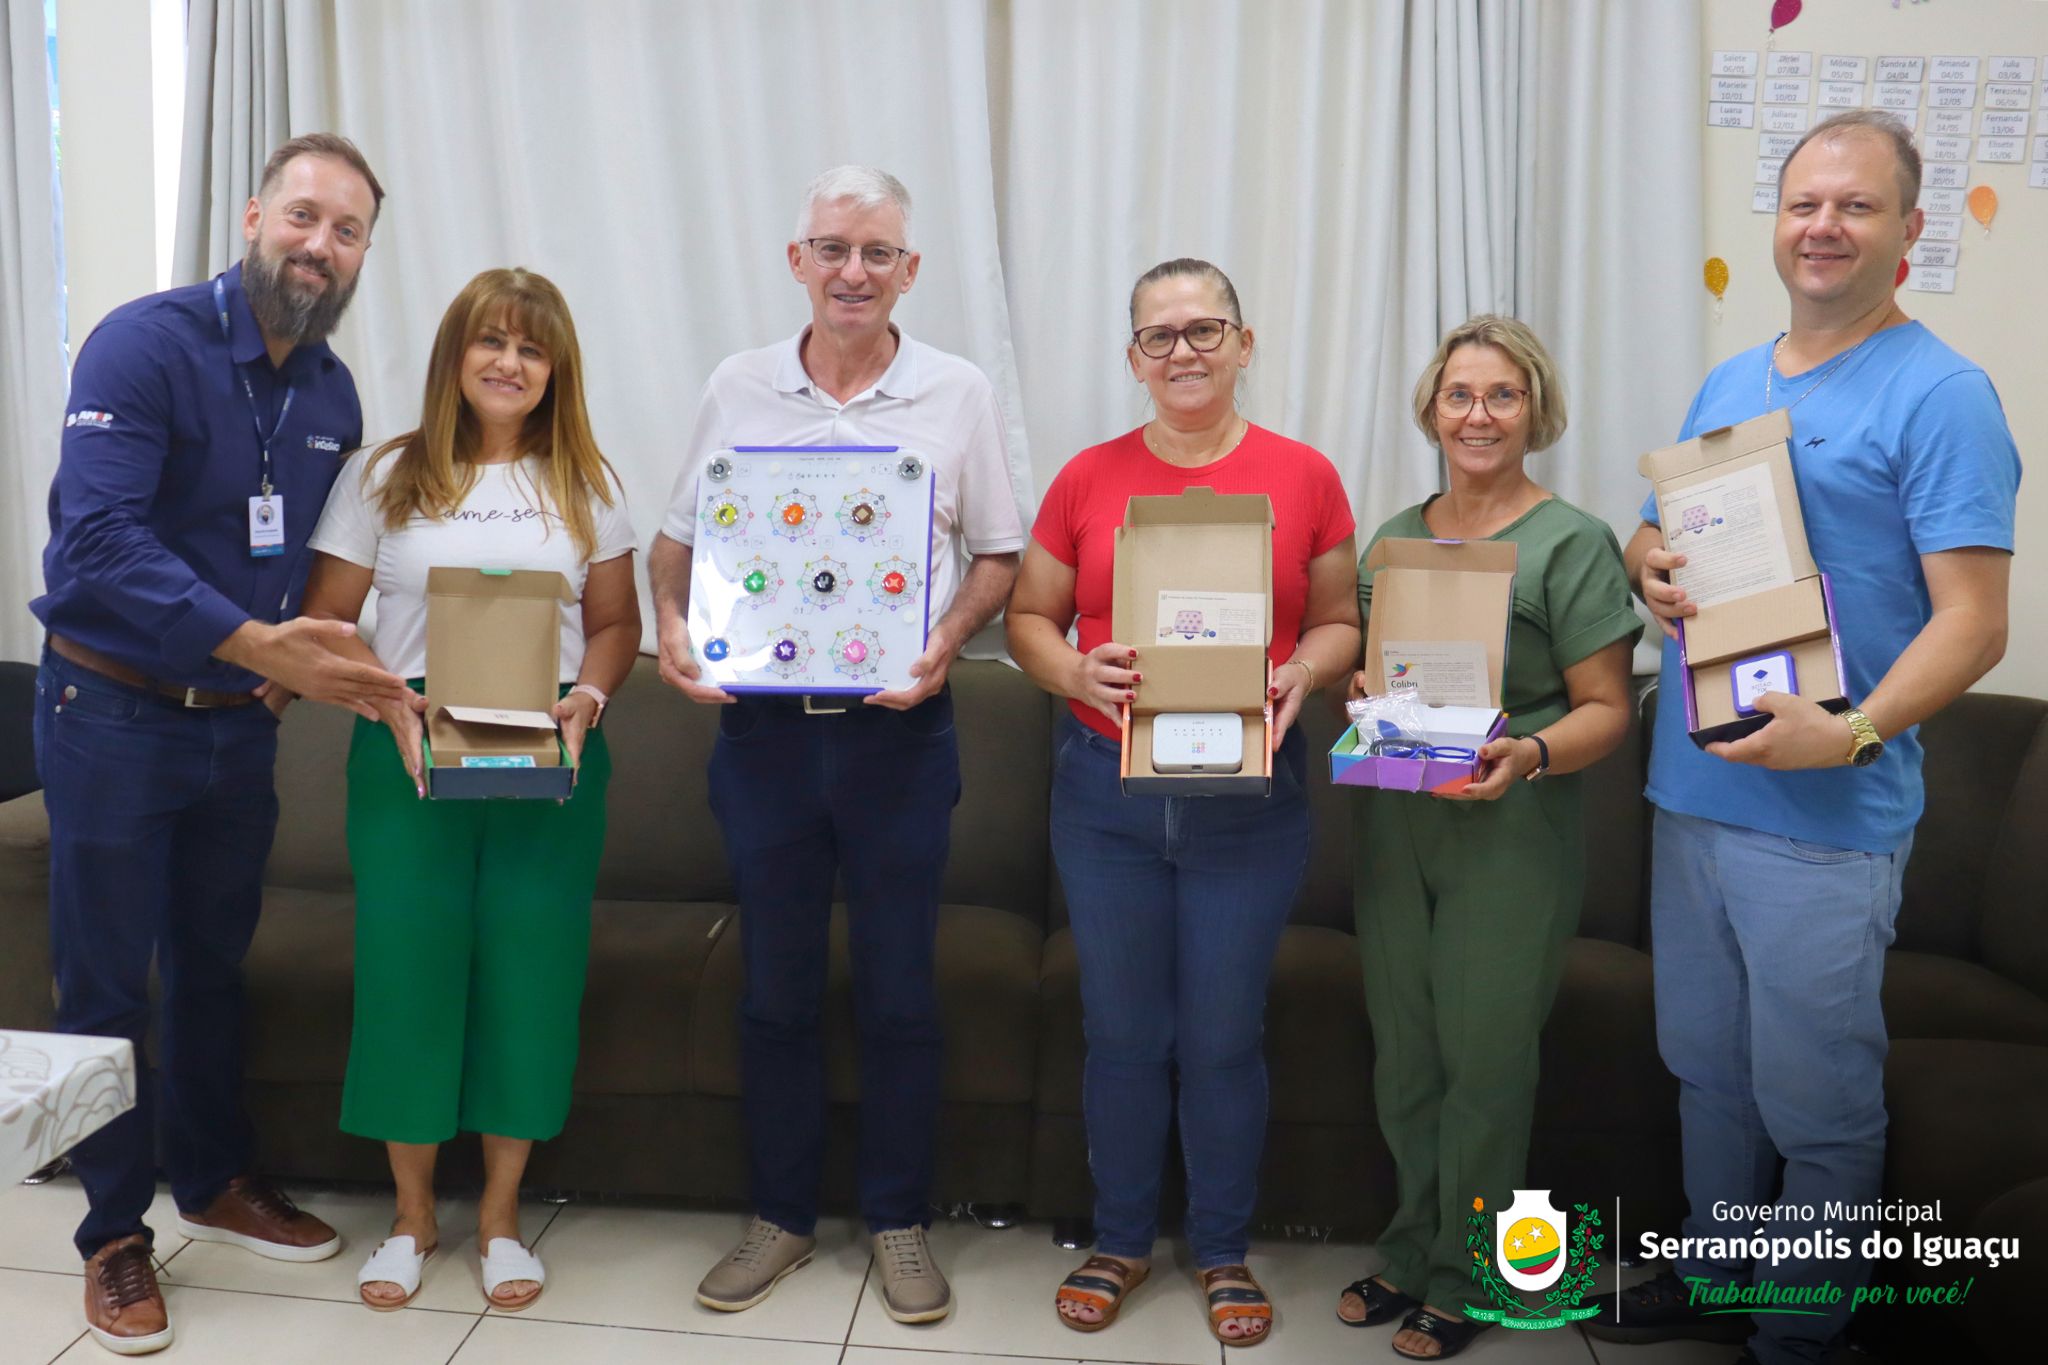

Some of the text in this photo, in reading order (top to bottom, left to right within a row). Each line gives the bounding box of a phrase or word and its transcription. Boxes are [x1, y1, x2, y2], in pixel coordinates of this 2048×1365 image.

[1880, 59, 1906, 68] Sandra
[1938, 60, 1970, 68] Amanda
[1777, 66, 1800, 74] 07/02
[1831, 71, 1854, 79] 05/03
[1941, 71, 1964, 79] 04/05
[1774, 82, 1799, 90] Larissa
[1938, 86, 1967, 95] Simone
[1721, 92, 1743, 100] 10/01
[1939, 98, 1961, 106] 12/05
[1720, 105, 1743, 114] Luana
[1986, 114, 2023, 122] Fernanda
[1992, 126, 2015, 134] 13/06
[1919, 245, 1952, 253] Gustavo
[440, 507, 541, 523] ame-se
[1391, 680, 1418, 688] Colibri
